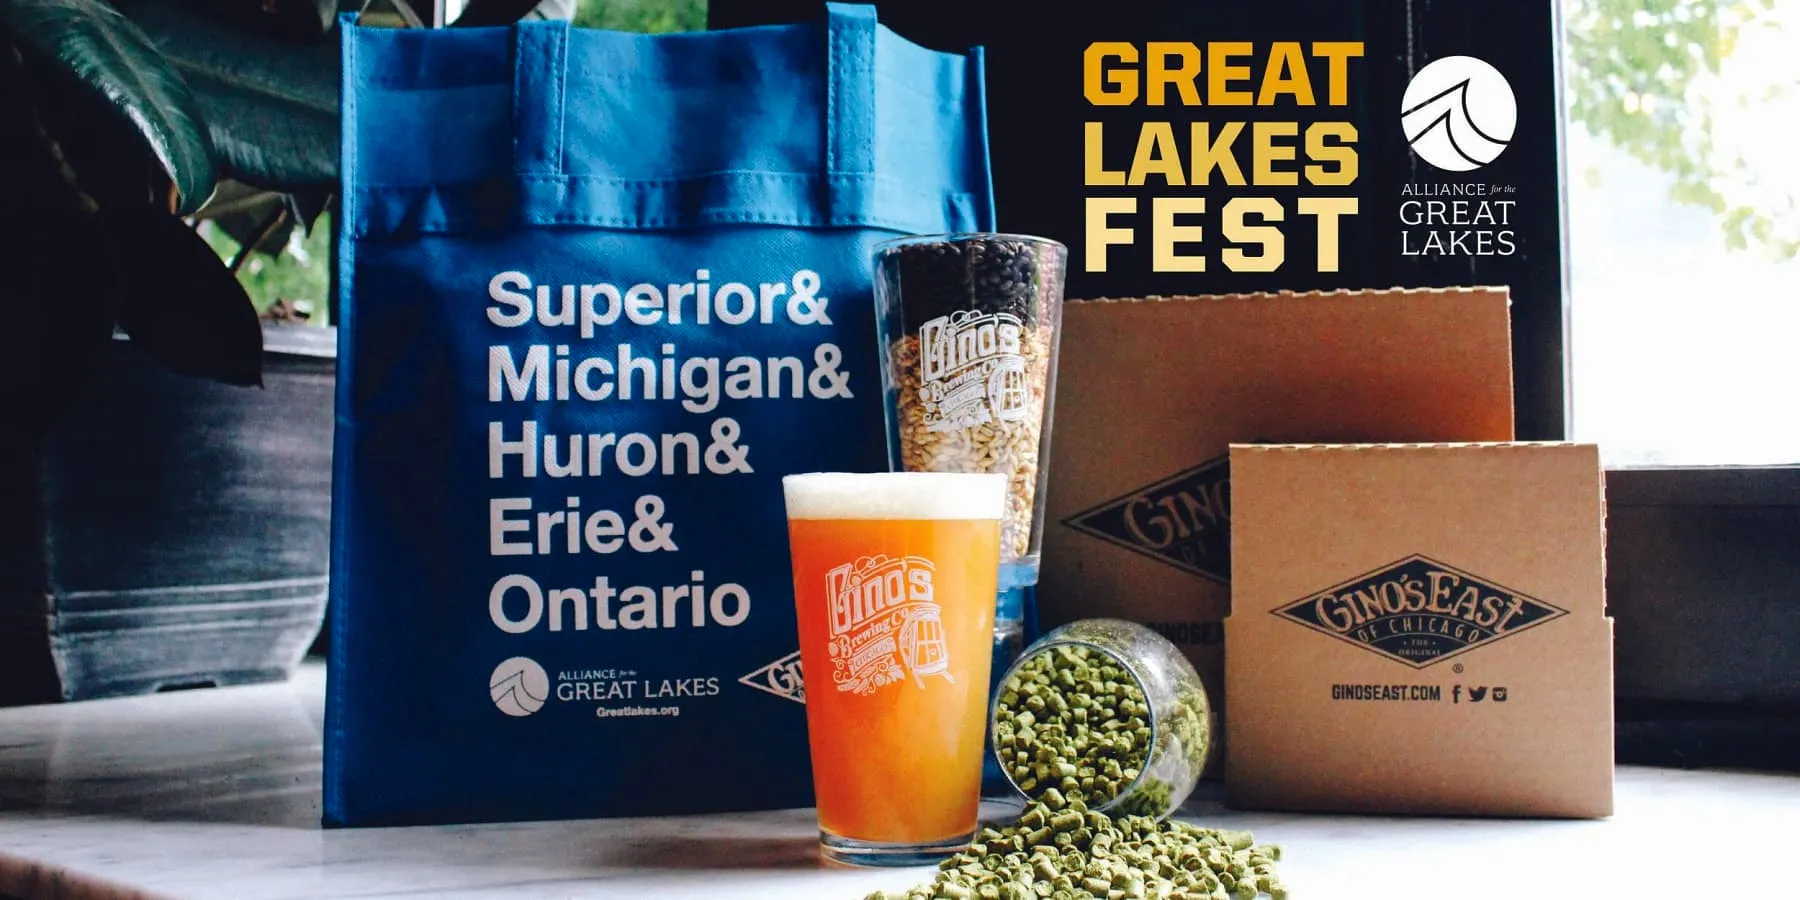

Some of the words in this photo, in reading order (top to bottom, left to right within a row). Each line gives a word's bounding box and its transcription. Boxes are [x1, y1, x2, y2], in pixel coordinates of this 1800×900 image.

[486, 269, 833, 339] Superior&
[488, 343, 854, 413] Michigan&
[488, 417, 754, 479] Huron&
[489, 495, 679, 556] Erie&
[488, 570, 751, 634] Ontario
[826, 561, 934, 636] Gino's
[1315, 573, 1425, 634] GINO'S
[1357, 623, 1378, 643] OF
[1388, 614, 1480, 643] CHICAGO
[557, 681, 637, 702] GREAT
[644, 677, 720, 699] LAKES
[558, 669, 616, 681] ALLIANCE
[1332, 685, 1441, 701] GINOSEAST.COM
[596, 705, 680, 718] Greatlakes.org
